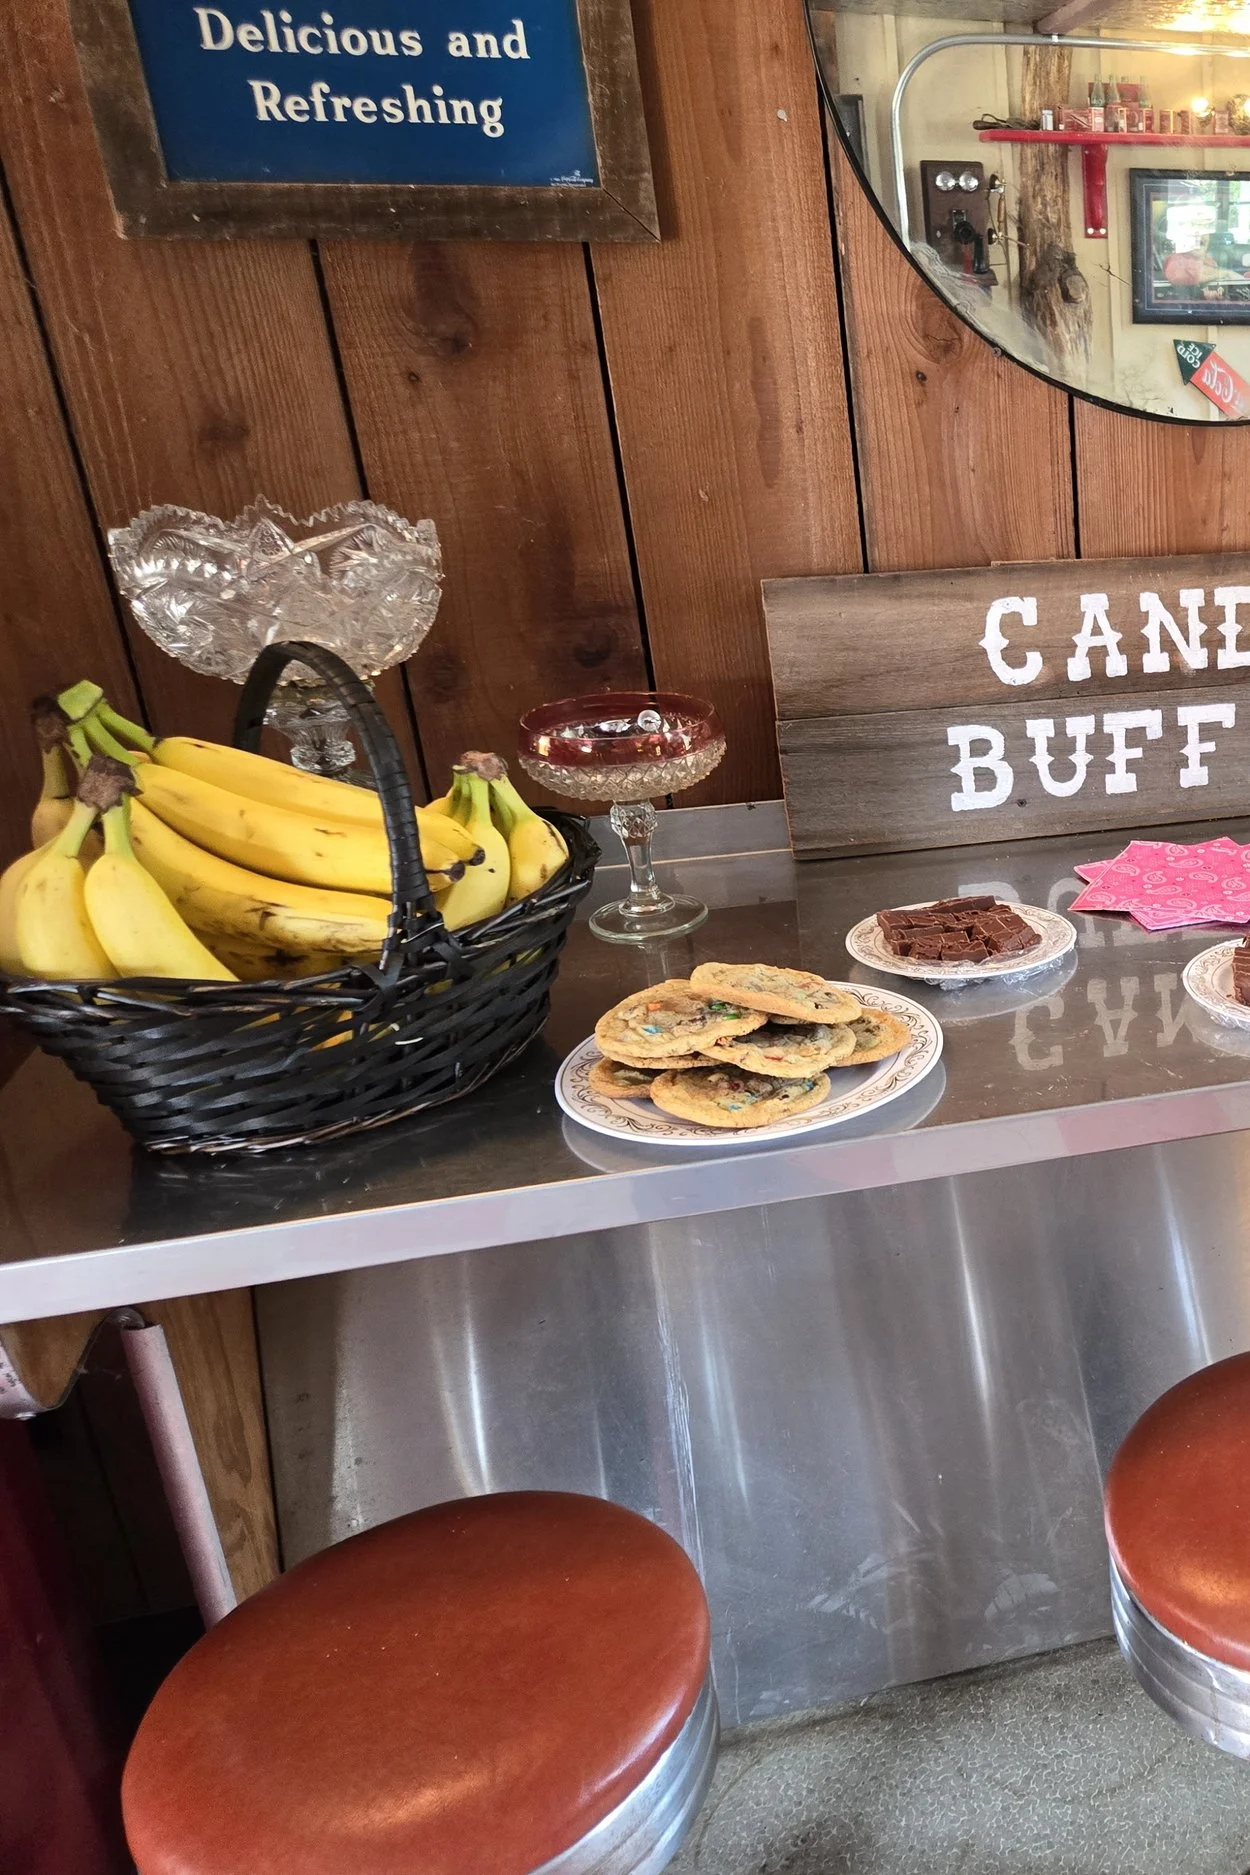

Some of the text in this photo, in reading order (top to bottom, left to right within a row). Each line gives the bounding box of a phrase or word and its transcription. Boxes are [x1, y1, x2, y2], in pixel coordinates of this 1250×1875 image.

[194, 6, 531, 60] Delicious and
[247, 80, 505, 138] Refreshing
